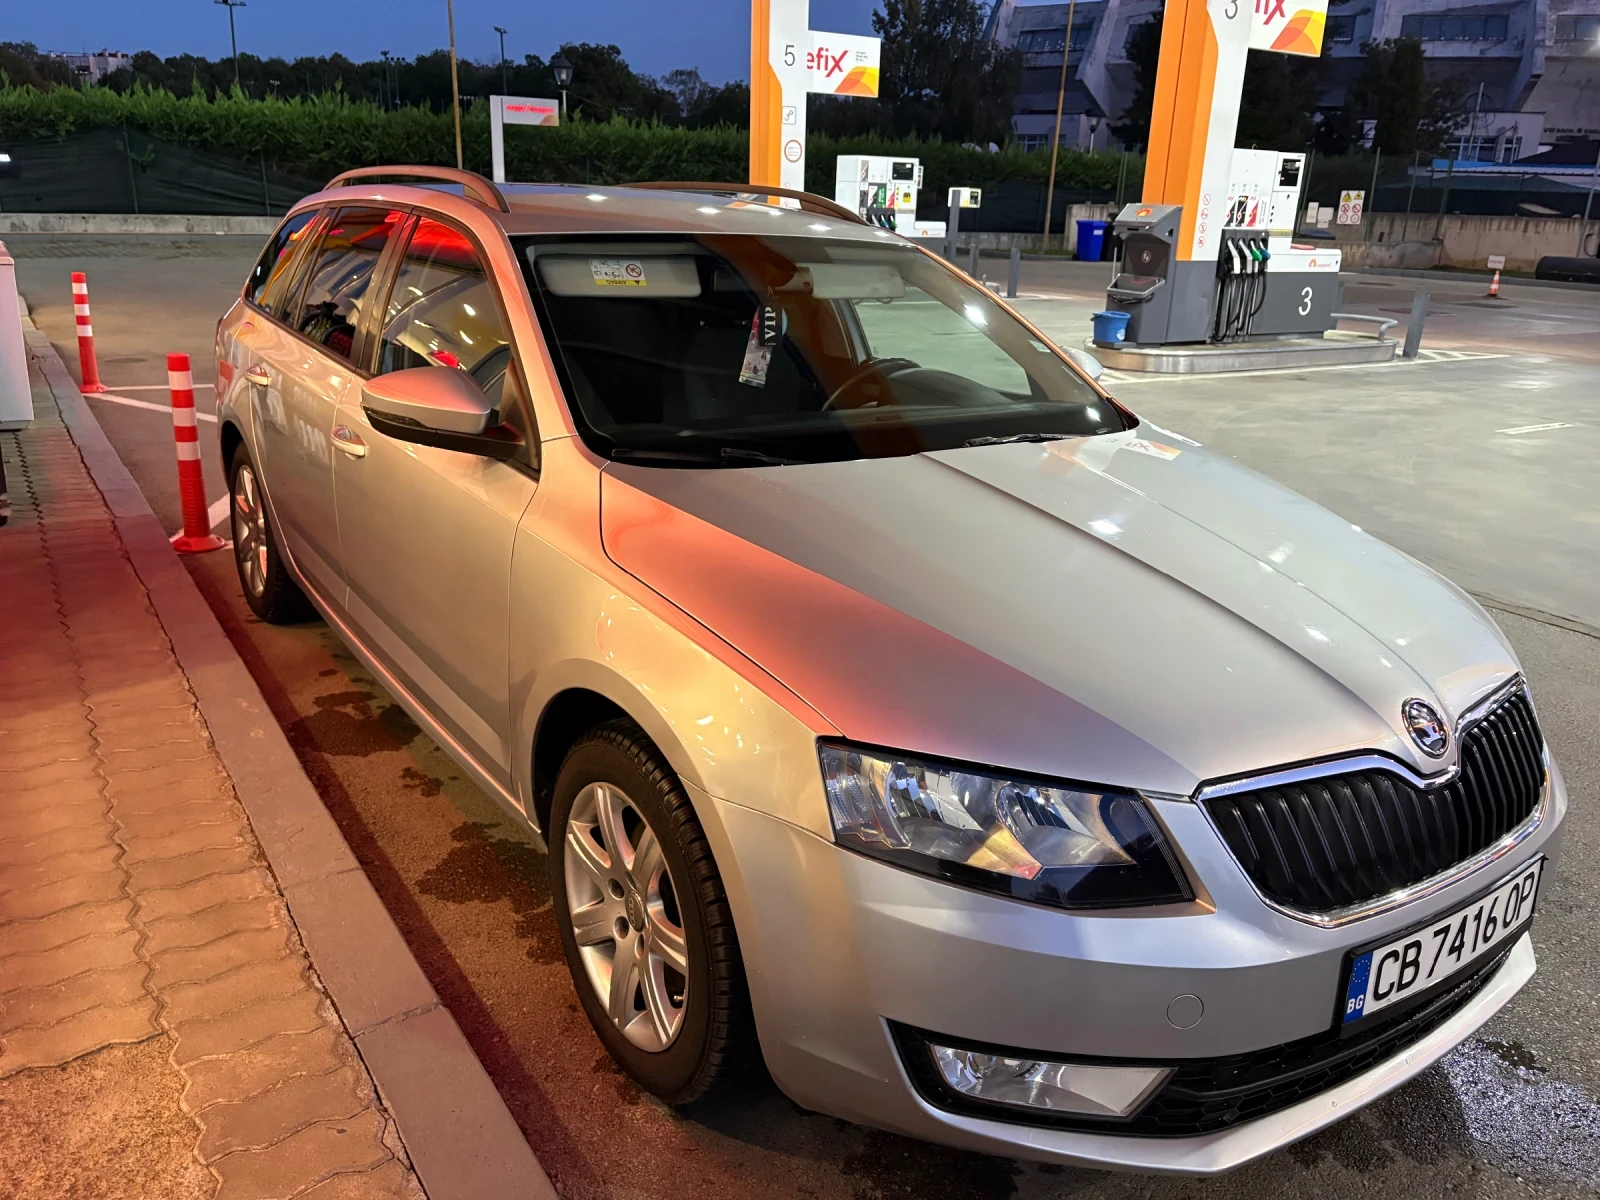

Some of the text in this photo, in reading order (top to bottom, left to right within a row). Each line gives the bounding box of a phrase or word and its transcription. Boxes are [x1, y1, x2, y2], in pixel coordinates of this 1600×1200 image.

[1224, 0, 1239, 20] 3
[784, 44, 796, 67] 5
[1298, 287, 1312, 315] 3
[765, 307, 776, 339] VIP
[1373, 939, 1423, 1002] CB
[1426, 895, 1500, 980] 7416
[1347, 995, 1364, 1014] BG
